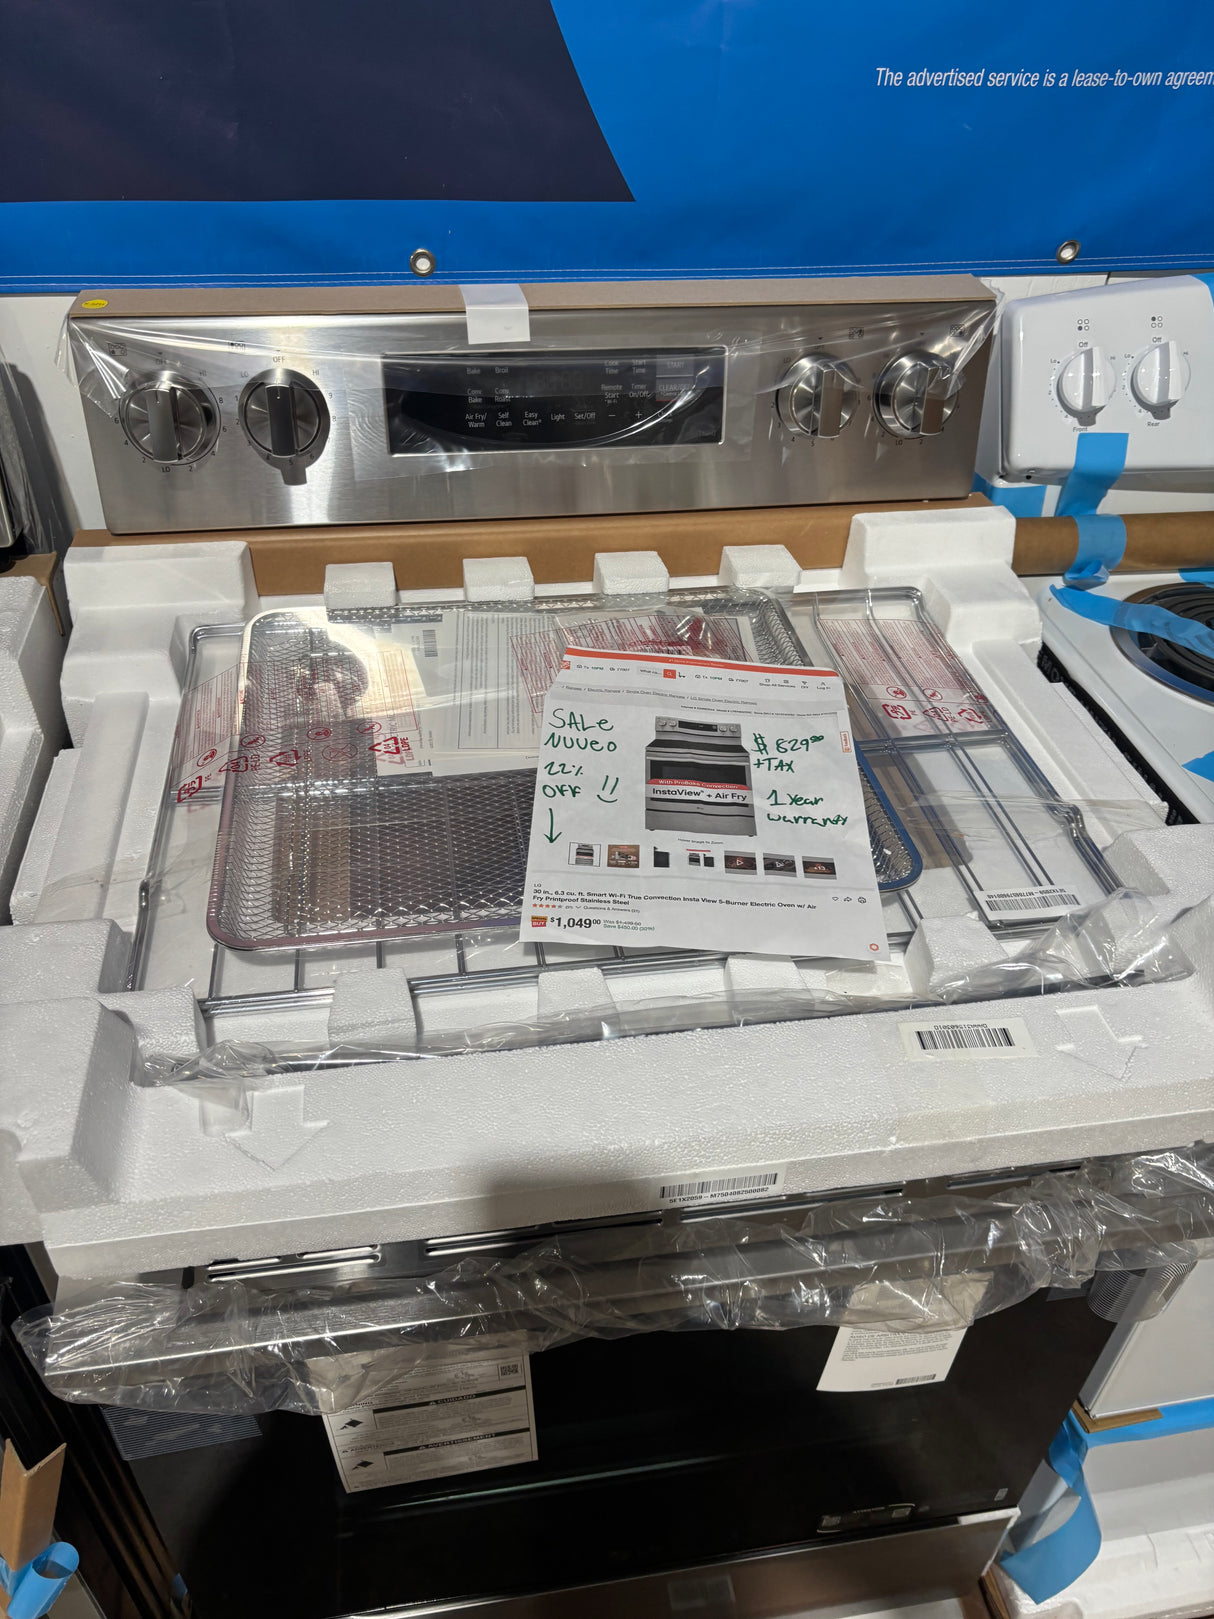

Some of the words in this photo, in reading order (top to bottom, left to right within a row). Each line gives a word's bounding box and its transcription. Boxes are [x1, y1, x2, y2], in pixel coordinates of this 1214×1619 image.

[876, 67, 902, 87] The
[907, 68, 984, 87] advertised
[987, 69, 1039, 87] service
[1043, 69, 1055, 87] is
[1059, 72, 1068, 87] a
[1071, 69, 1162, 87] lease-to-own
[605, 391, 619, 399] Start
[465, 413, 475, 421] Air
[476, 412, 487, 422] Fry/
[525, 411, 538, 420] Easy
[551, 413, 565, 421] Light
[574, 412, 596, 420] Set/Off
[469, 420, 485, 428] Warm
[496, 419, 512, 427] Clean
[400, 737, 411, 751] LDPE
[732, 793, 747, 801] Fry
[766, 790, 786, 806] 1
